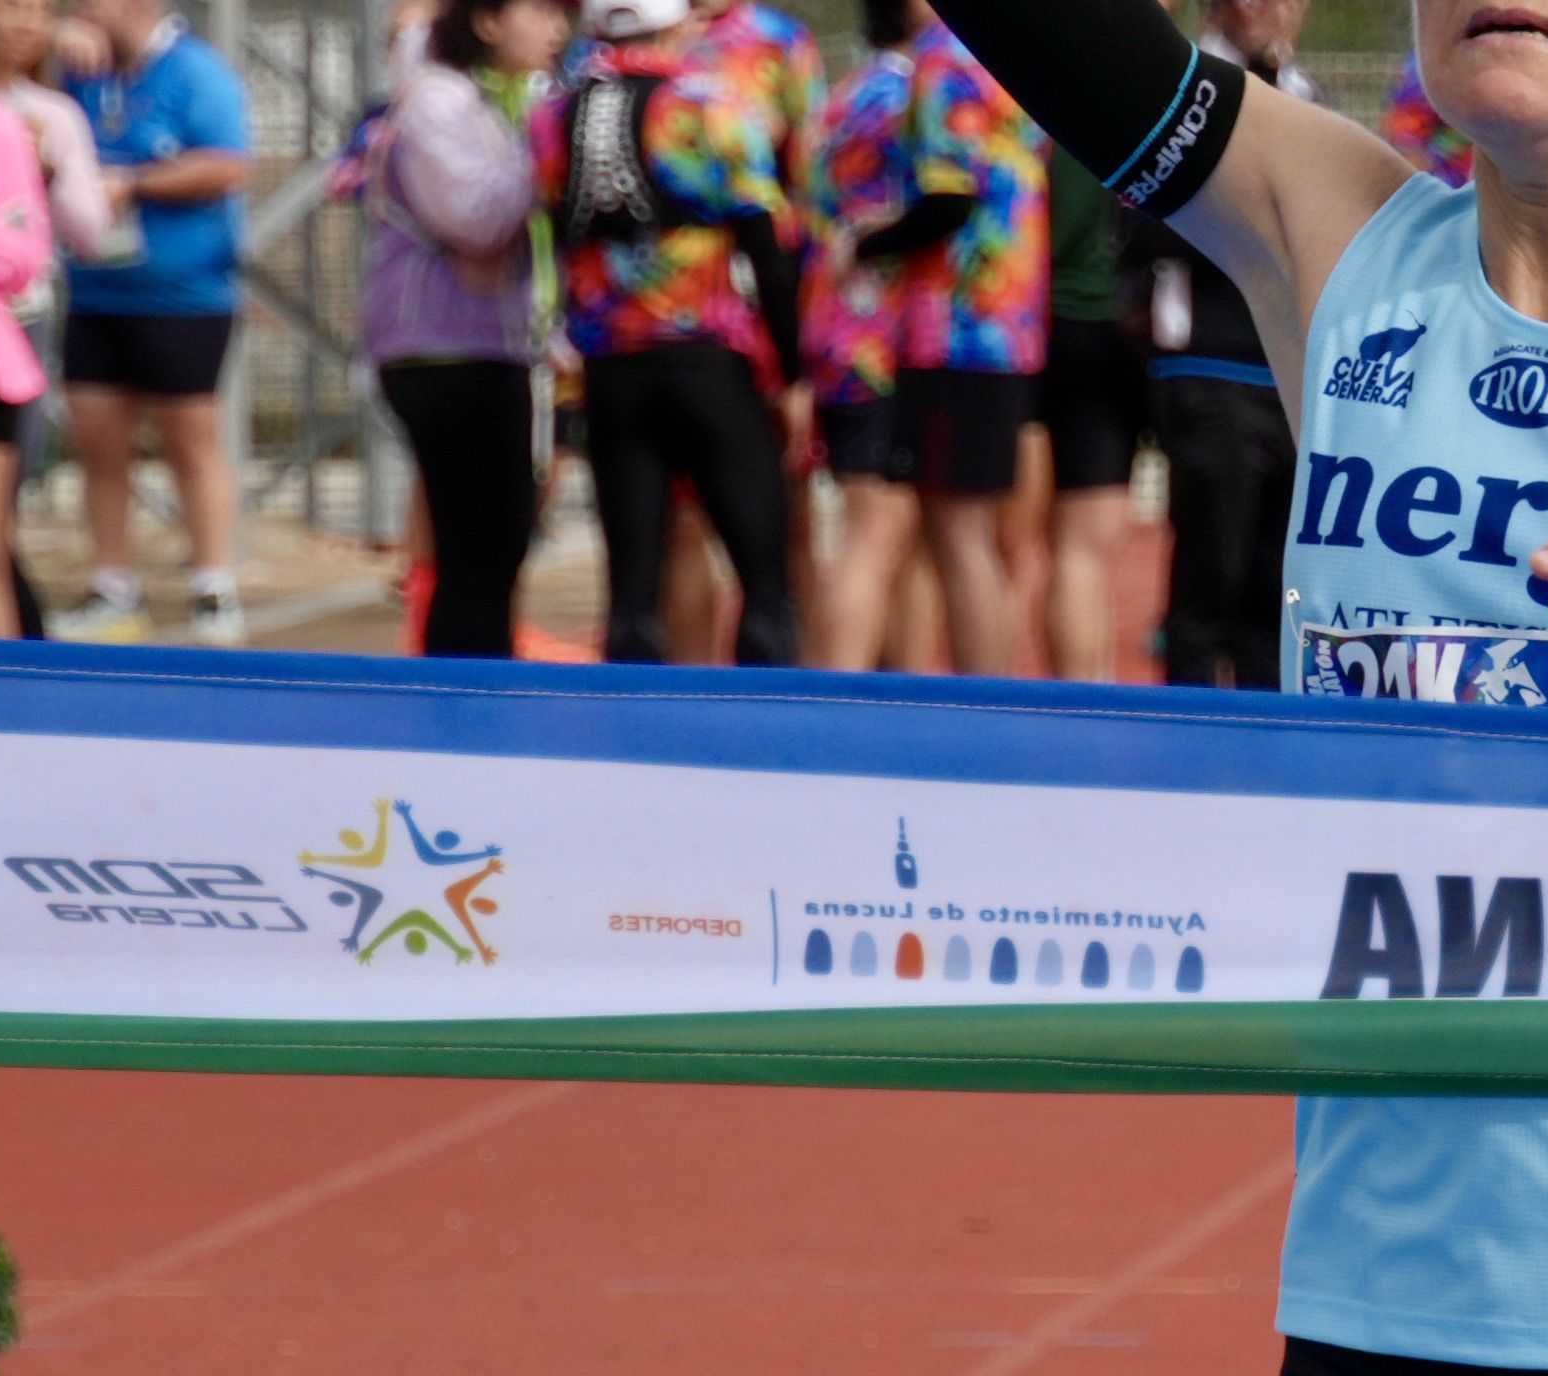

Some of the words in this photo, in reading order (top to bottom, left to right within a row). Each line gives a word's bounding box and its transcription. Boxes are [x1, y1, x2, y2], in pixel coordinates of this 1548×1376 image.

[1123, 78, 1218, 205] COMPRE
[1492, 343, 1541, 358] AGUACATE
[1333, 354, 1415, 393] CUEVA
